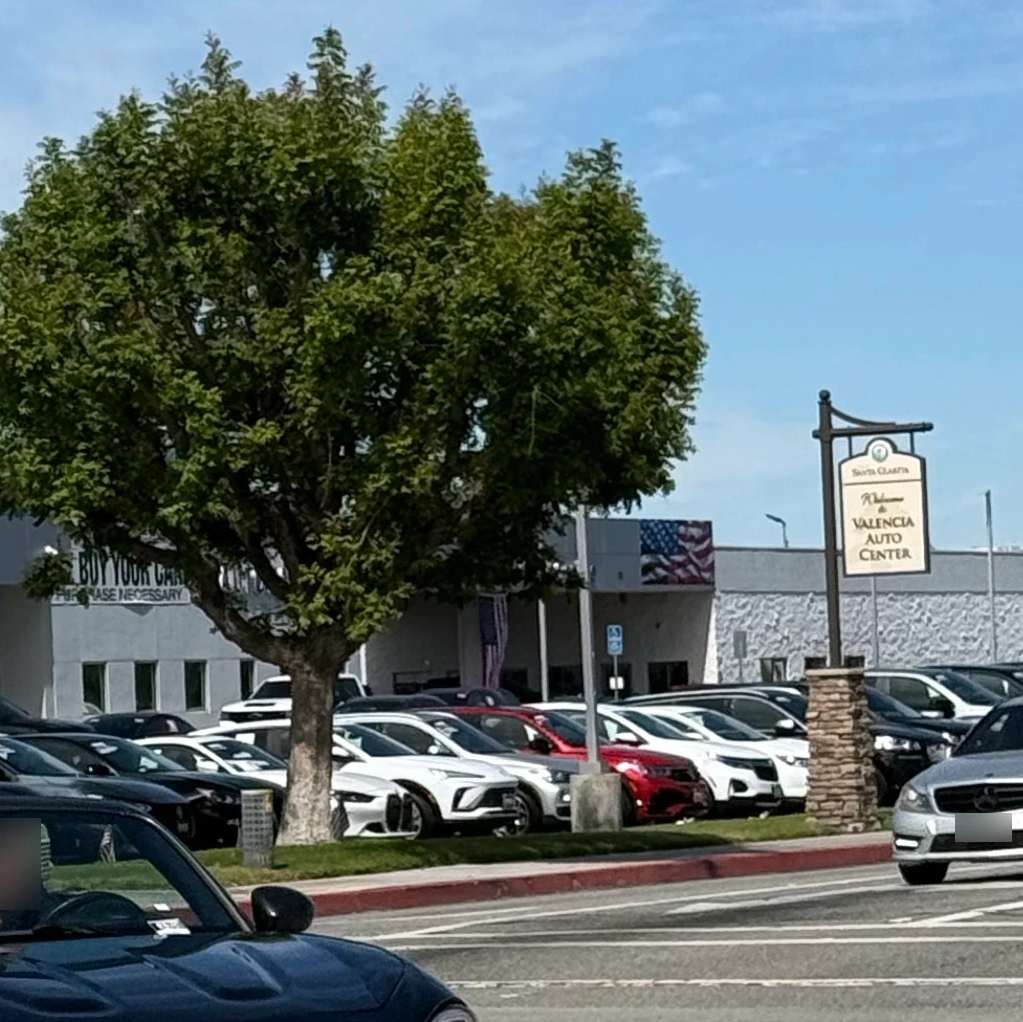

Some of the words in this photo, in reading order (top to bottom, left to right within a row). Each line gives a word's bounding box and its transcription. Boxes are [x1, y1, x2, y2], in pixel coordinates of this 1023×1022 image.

[851, 516, 915, 530] VALENCIA
[865, 533, 902, 545] AUTO
[859, 548, 912, 561] CENTER
